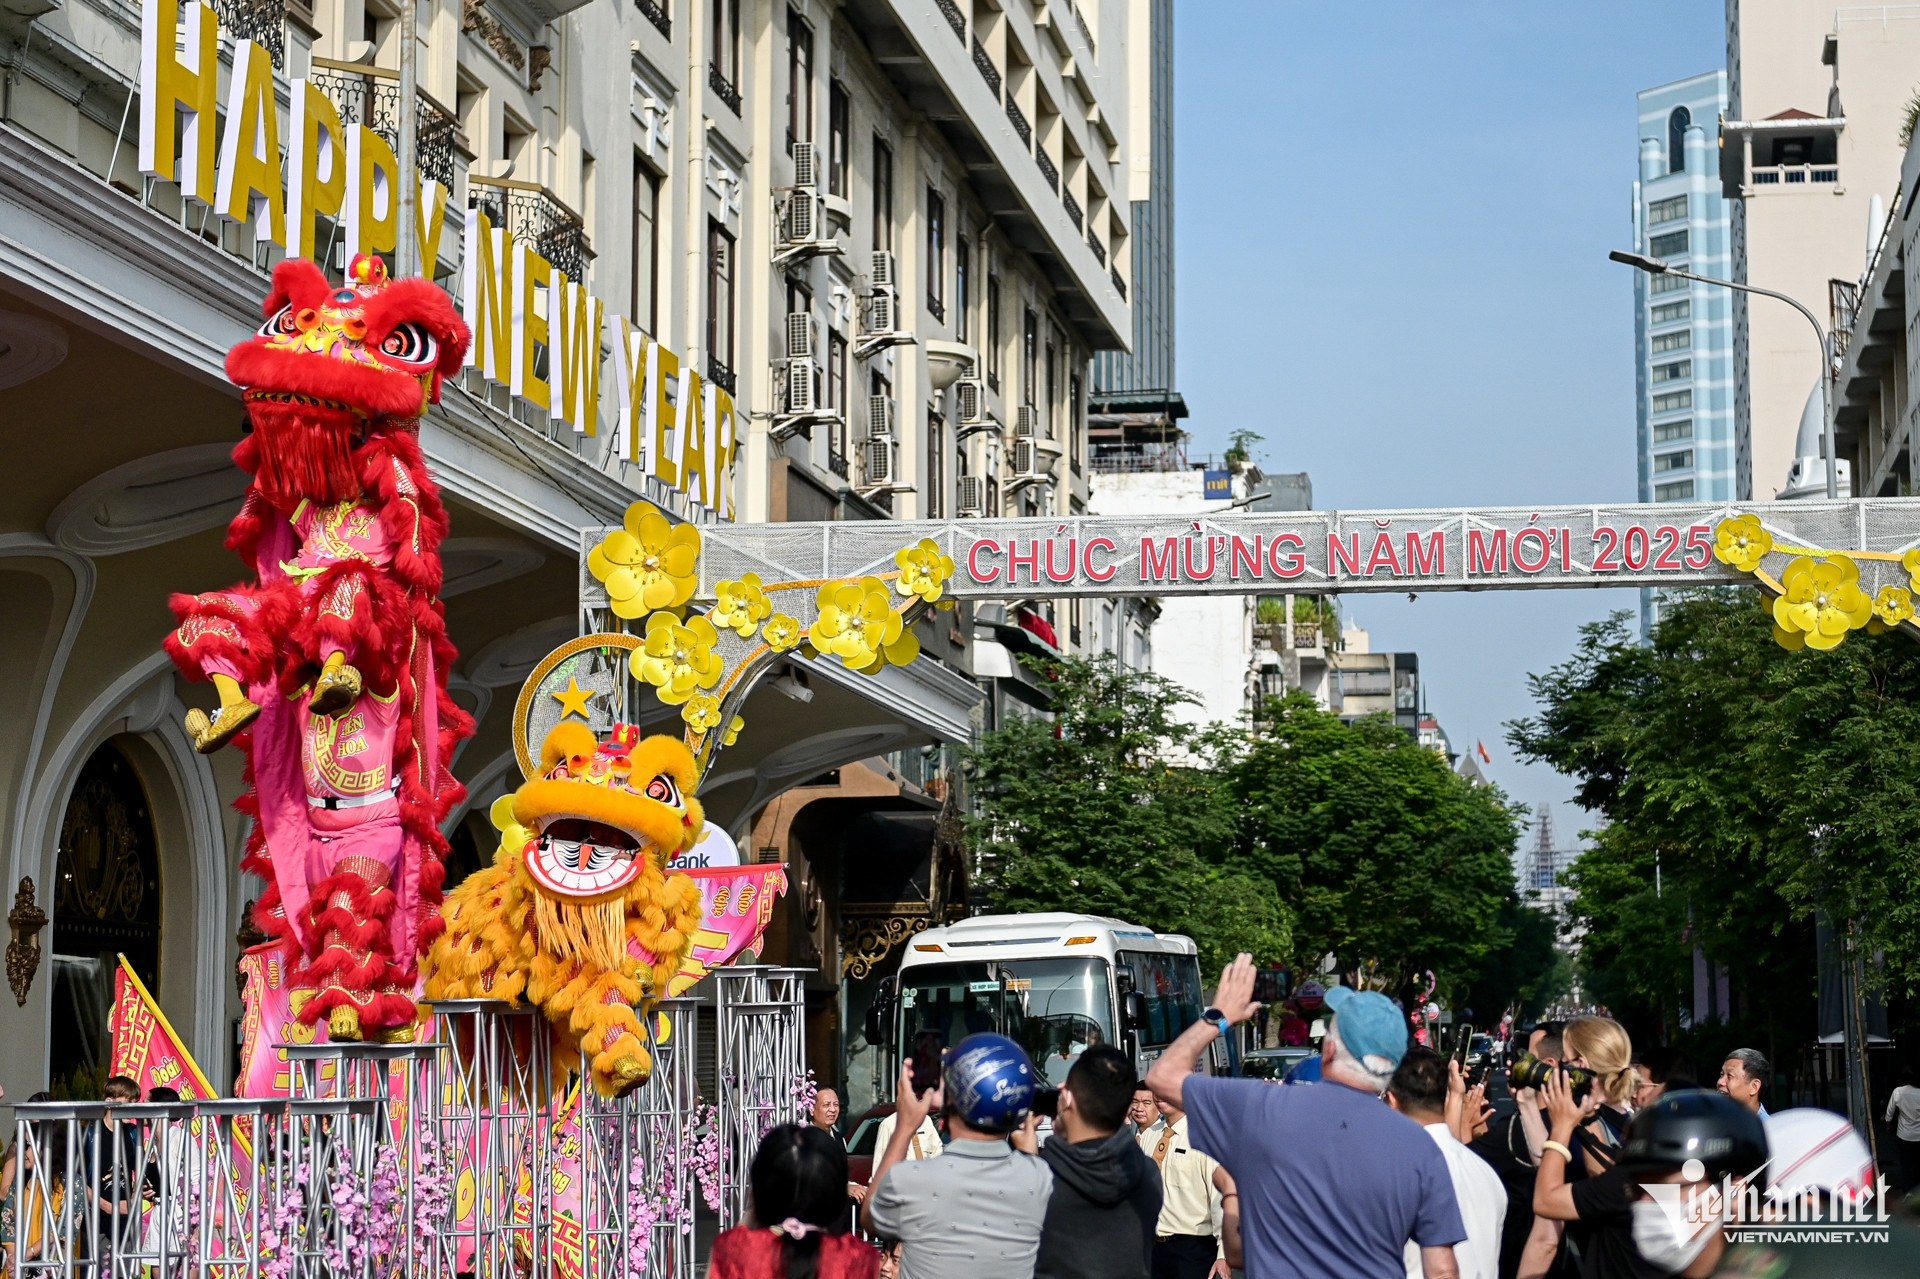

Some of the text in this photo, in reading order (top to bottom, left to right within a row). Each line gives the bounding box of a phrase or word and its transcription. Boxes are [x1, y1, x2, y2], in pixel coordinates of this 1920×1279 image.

[139, 0, 736, 522] HAPPY NEW YEAR
[967, 512, 1714, 583] CHÚC MỪNG NĂM MỚI 2025
[337, 735, 369, 758] HOA
